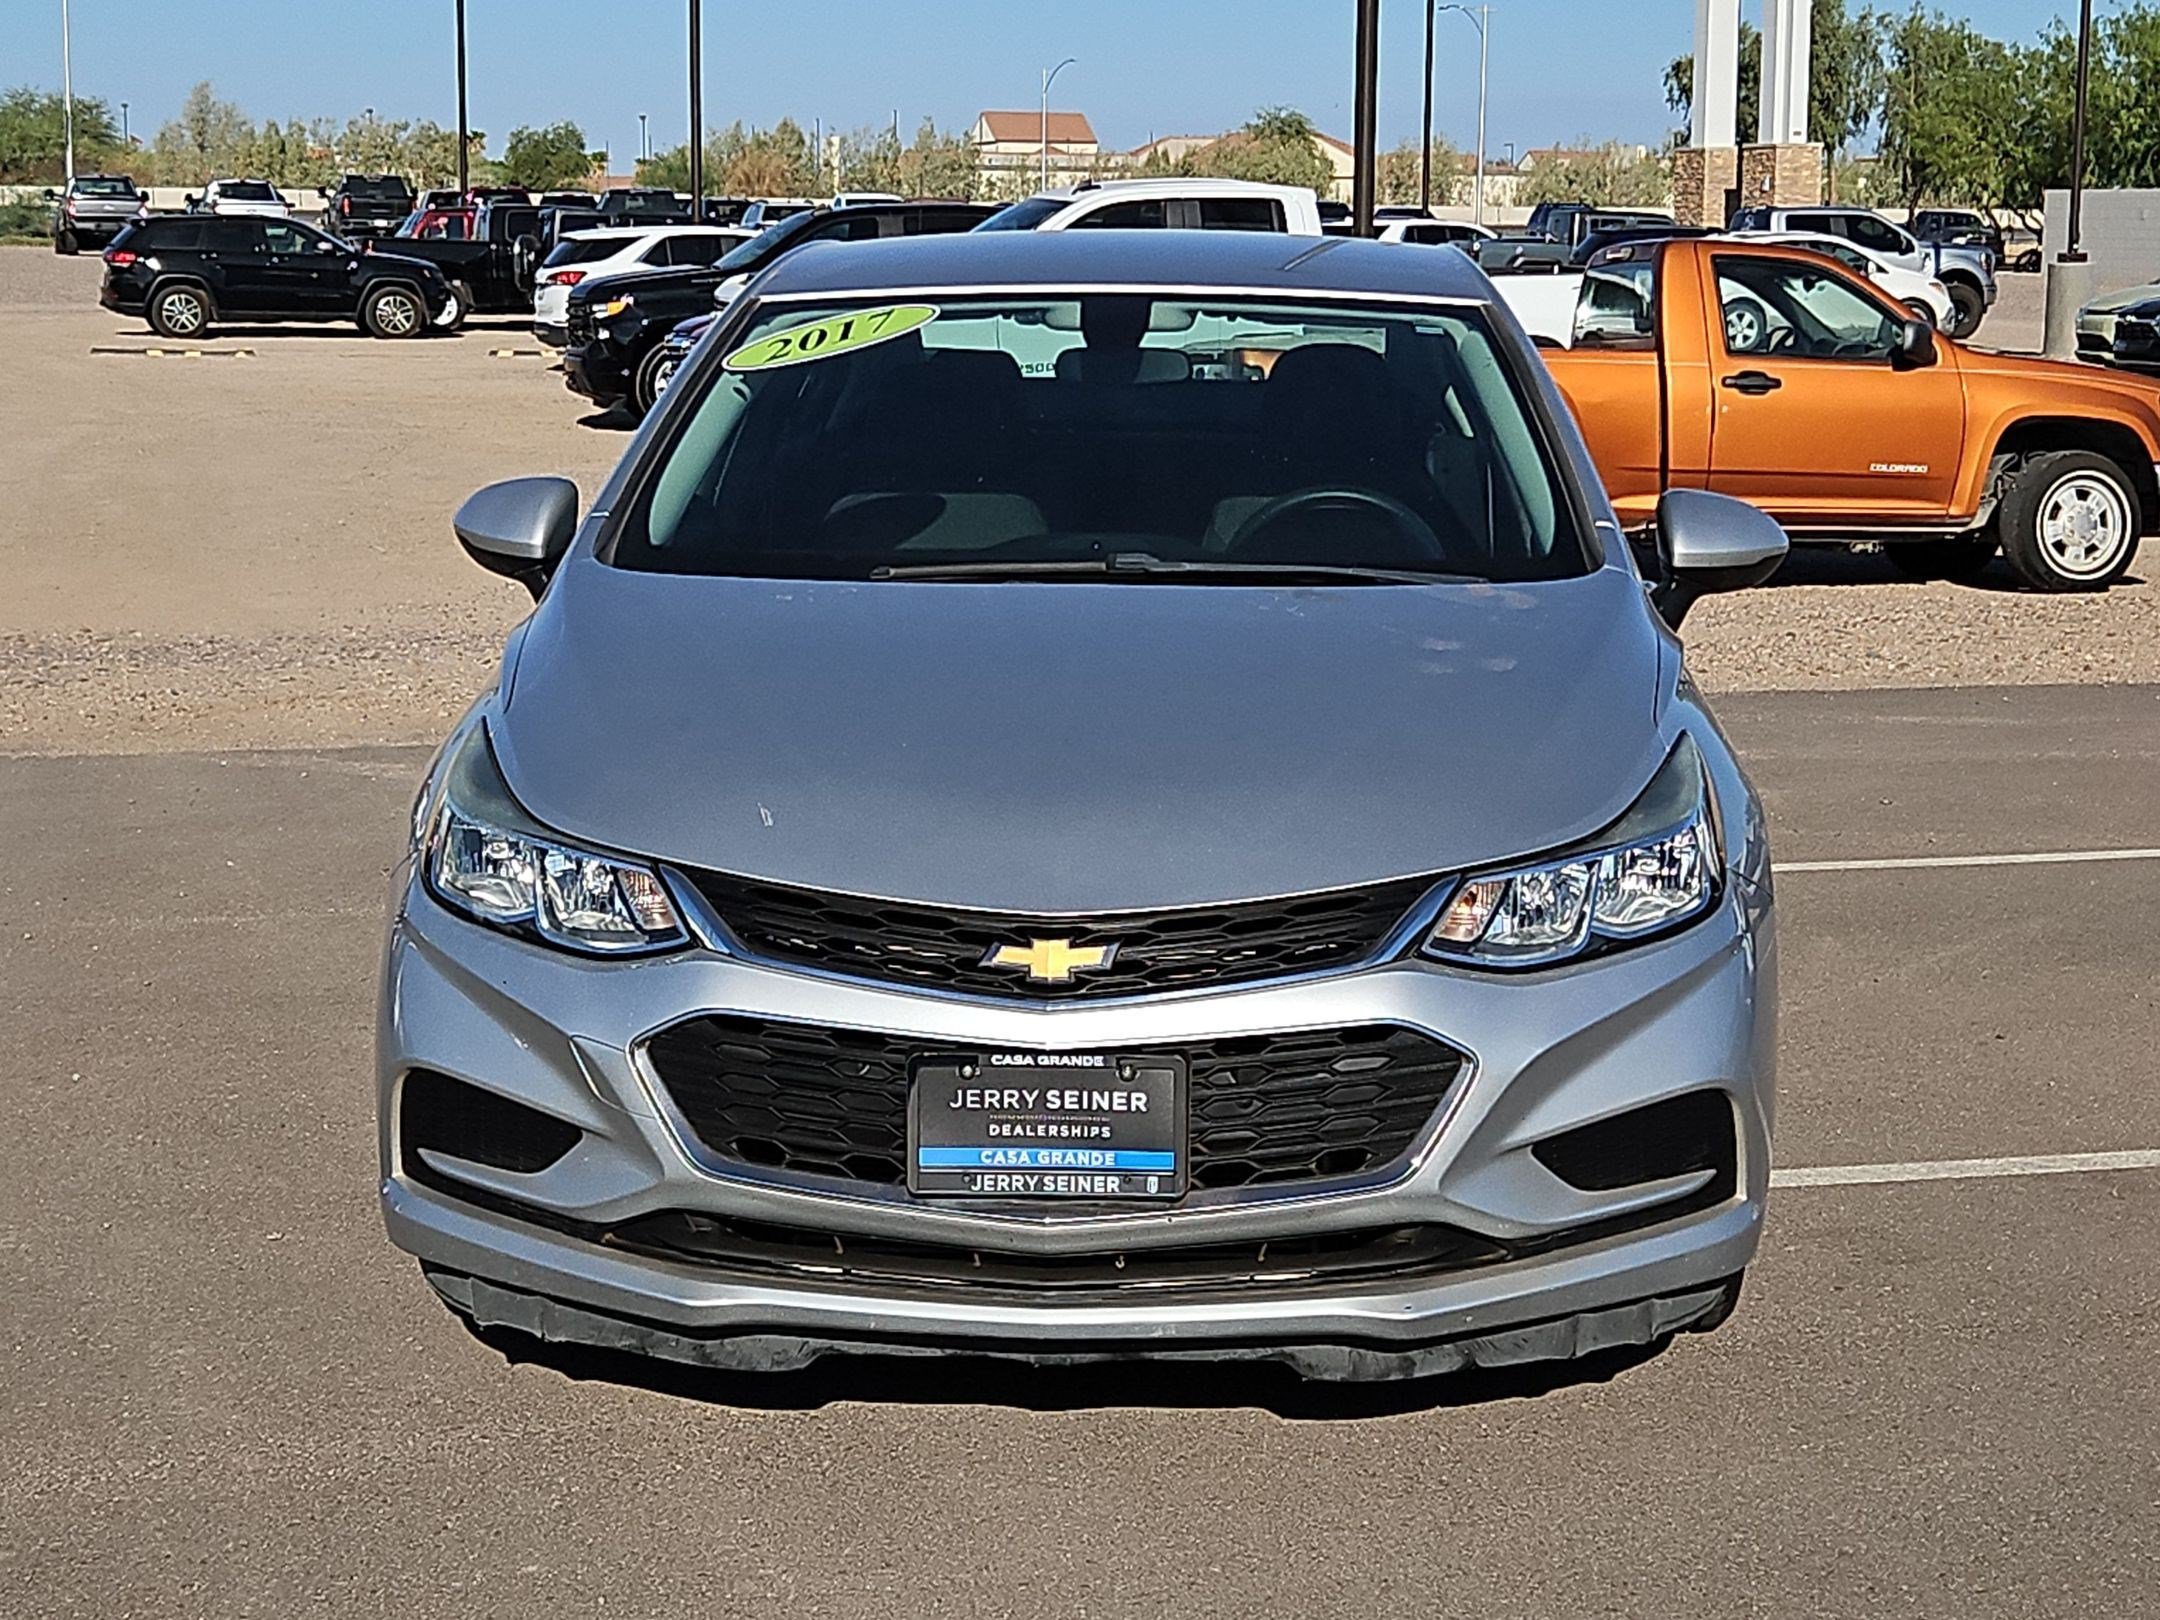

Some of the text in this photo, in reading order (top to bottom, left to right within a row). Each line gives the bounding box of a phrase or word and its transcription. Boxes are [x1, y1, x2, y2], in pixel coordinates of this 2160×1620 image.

[764, 308, 896, 363] 2017
[1868, 463, 1929, 474] COLORADO
[990, 1054, 1105, 1067] CASA GRANDE
[949, 1088, 1148, 1112] JERRY SEINER
[988, 1124, 1112, 1139] DEALERSHIPS
[980, 1150, 1117, 1167] CASA GRANDE
[970, 1174, 1121, 1194] JERRY SEINER
